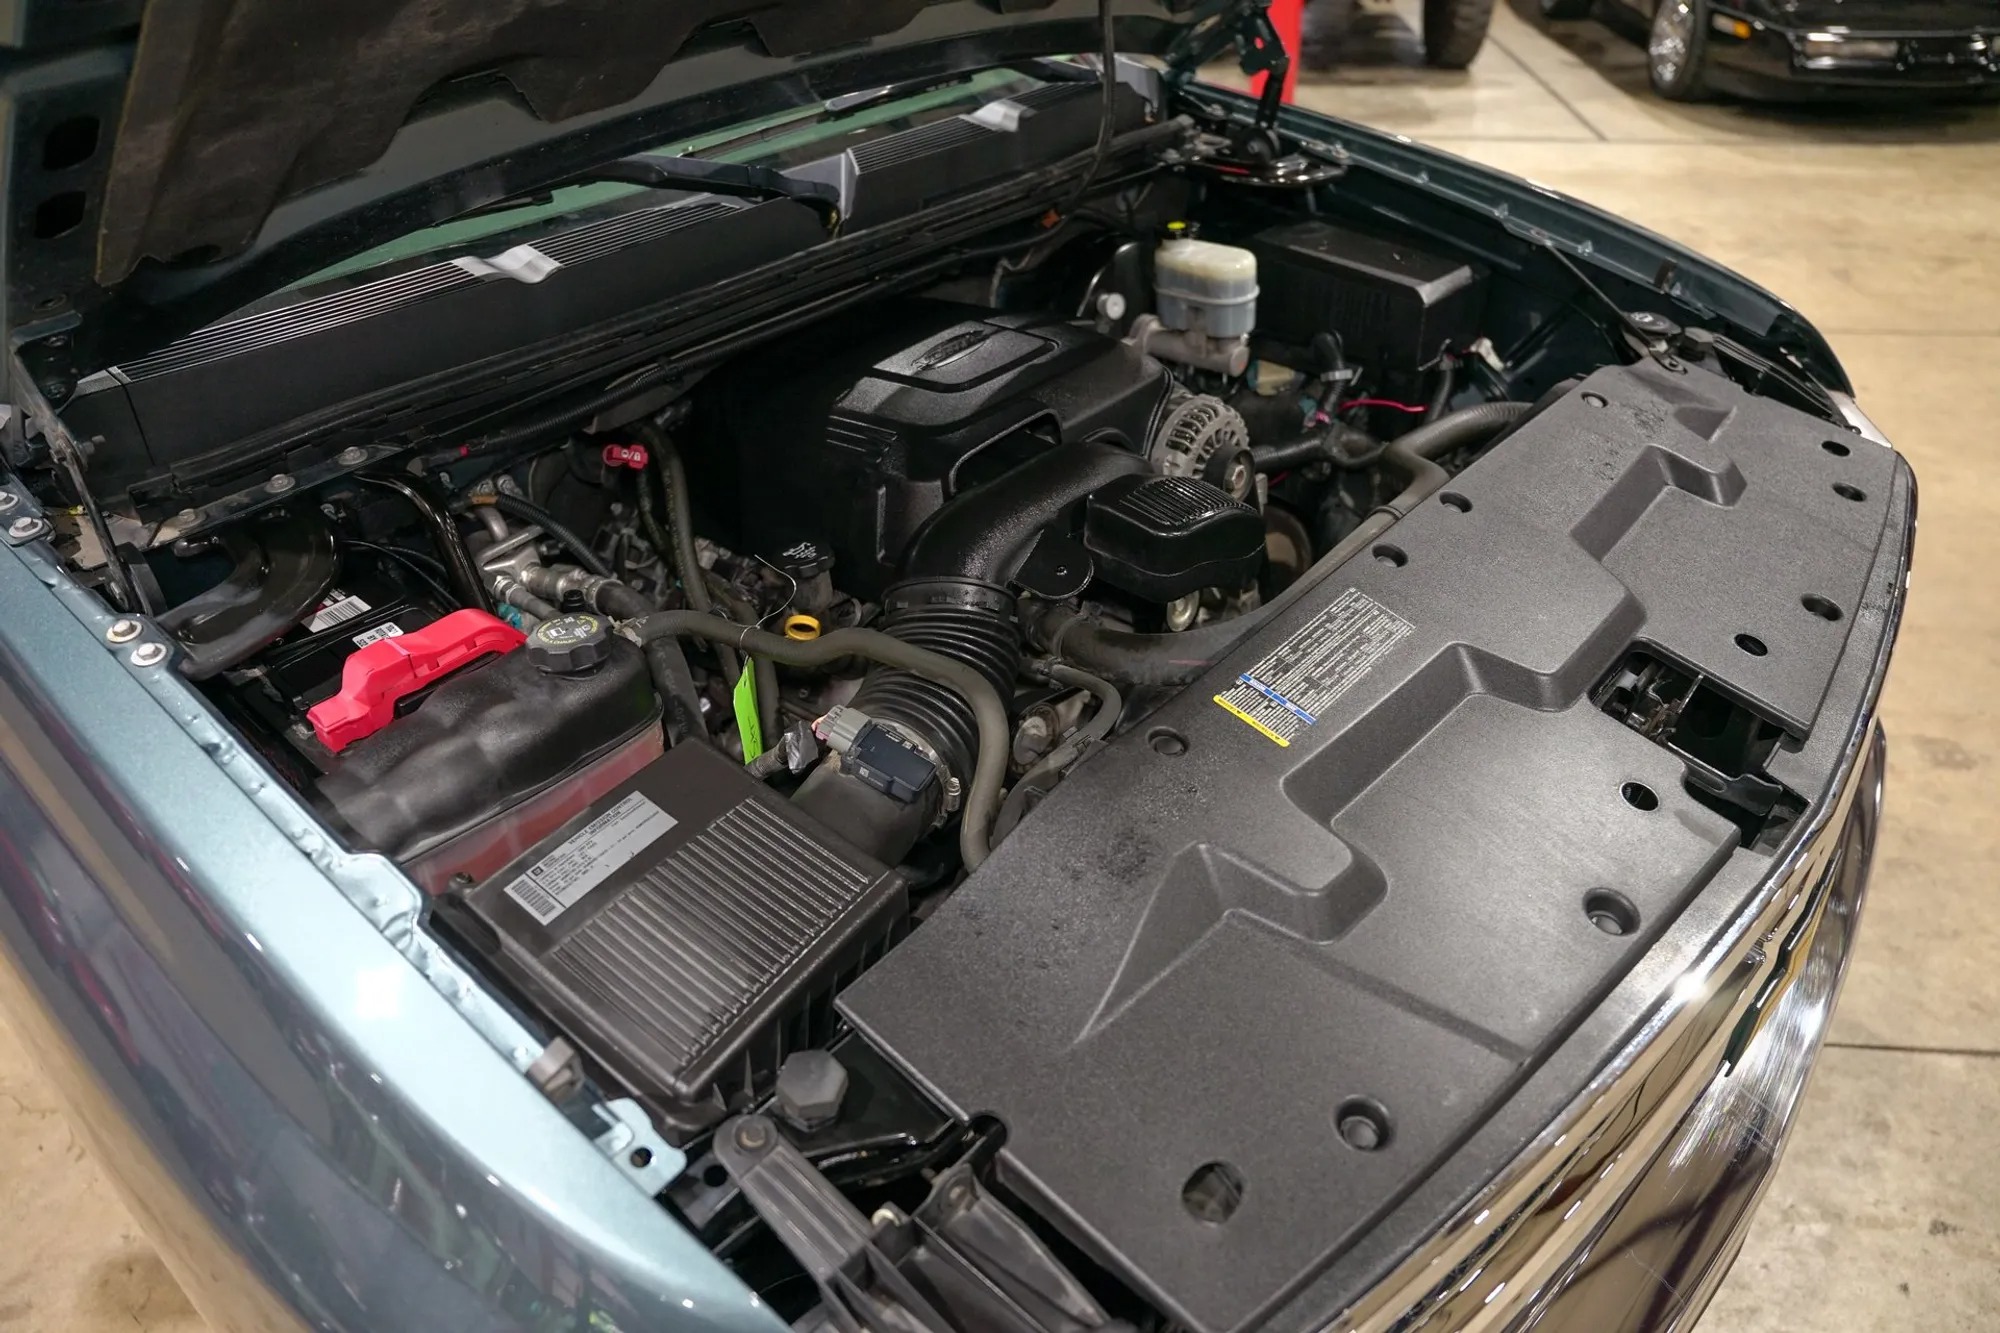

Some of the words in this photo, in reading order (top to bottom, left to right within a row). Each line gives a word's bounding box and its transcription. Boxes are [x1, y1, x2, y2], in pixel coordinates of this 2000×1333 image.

[588, 812, 611, 830] EMISSION
[611, 797, 633, 813] CONTROL
[588, 811, 621, 835] INFORMATION
